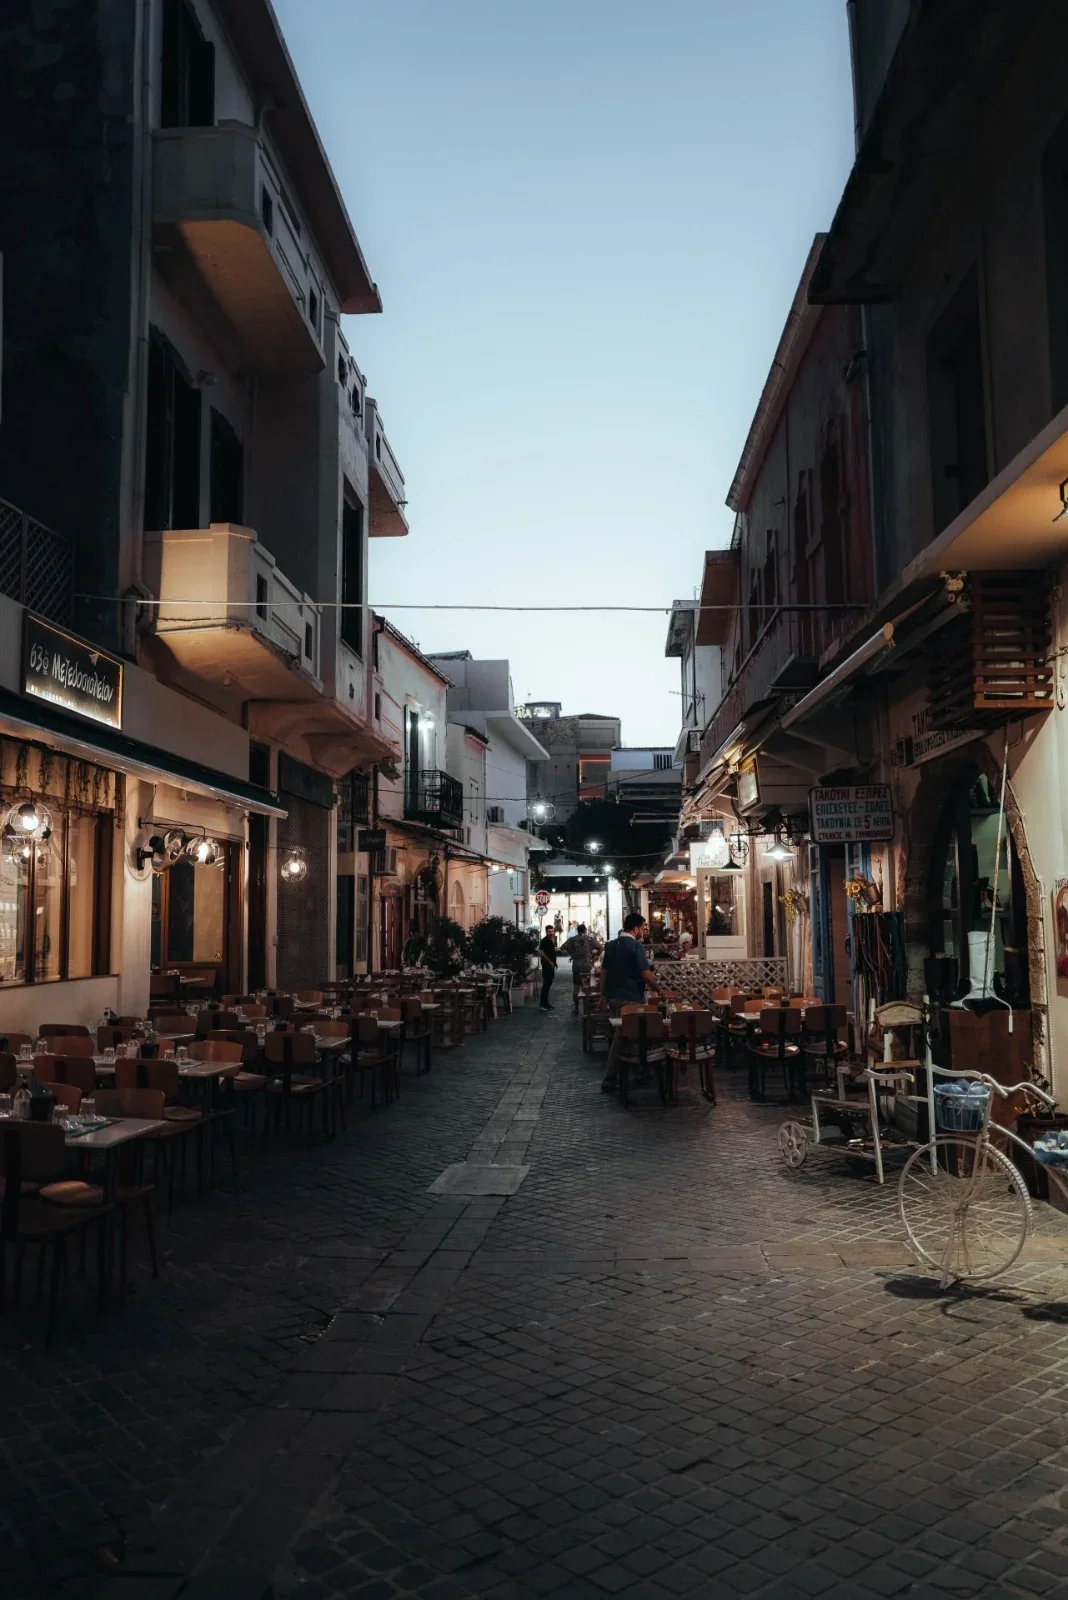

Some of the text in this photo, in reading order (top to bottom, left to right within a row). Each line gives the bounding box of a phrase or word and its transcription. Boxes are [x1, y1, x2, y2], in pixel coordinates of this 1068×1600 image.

[815, 787, 888, 801] ΤΑΚΟΥΝΙ ΕΞΠΡΕΣ
[816, 817, 852, 829] ΤΑΚΟΥΝΙΑ
[854, 817, 863, 828] ΣΕ
[864, 815, 872, 829] 5
[536, 894, 550, 904] STOP
